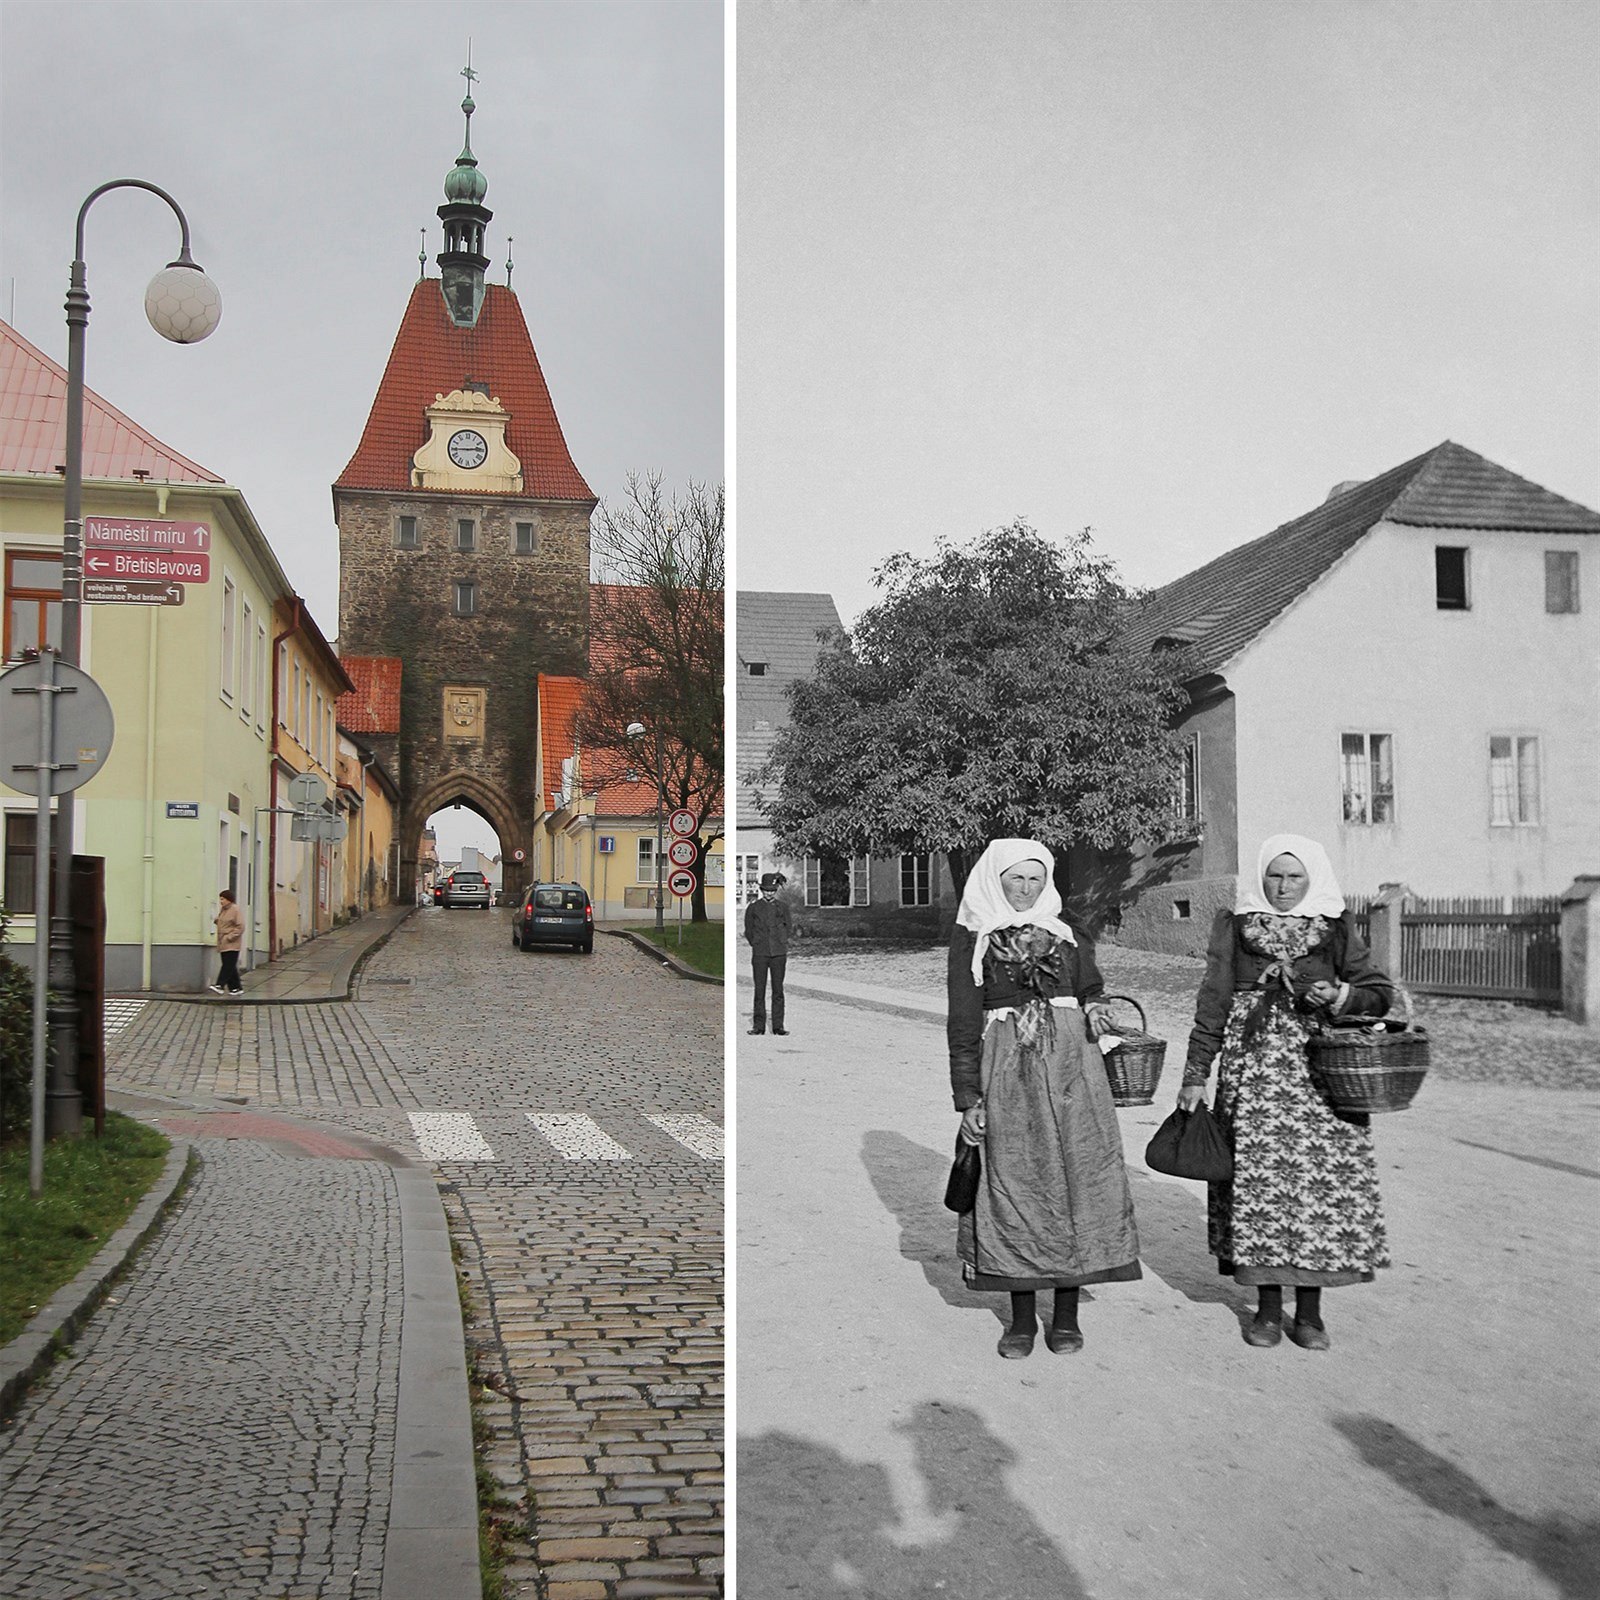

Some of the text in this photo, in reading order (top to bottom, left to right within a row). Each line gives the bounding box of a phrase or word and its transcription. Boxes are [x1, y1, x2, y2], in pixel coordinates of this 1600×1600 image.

[90, 523, 185, 544] Náměstí míru
[115, 555, 201, 576] Břetislavova
